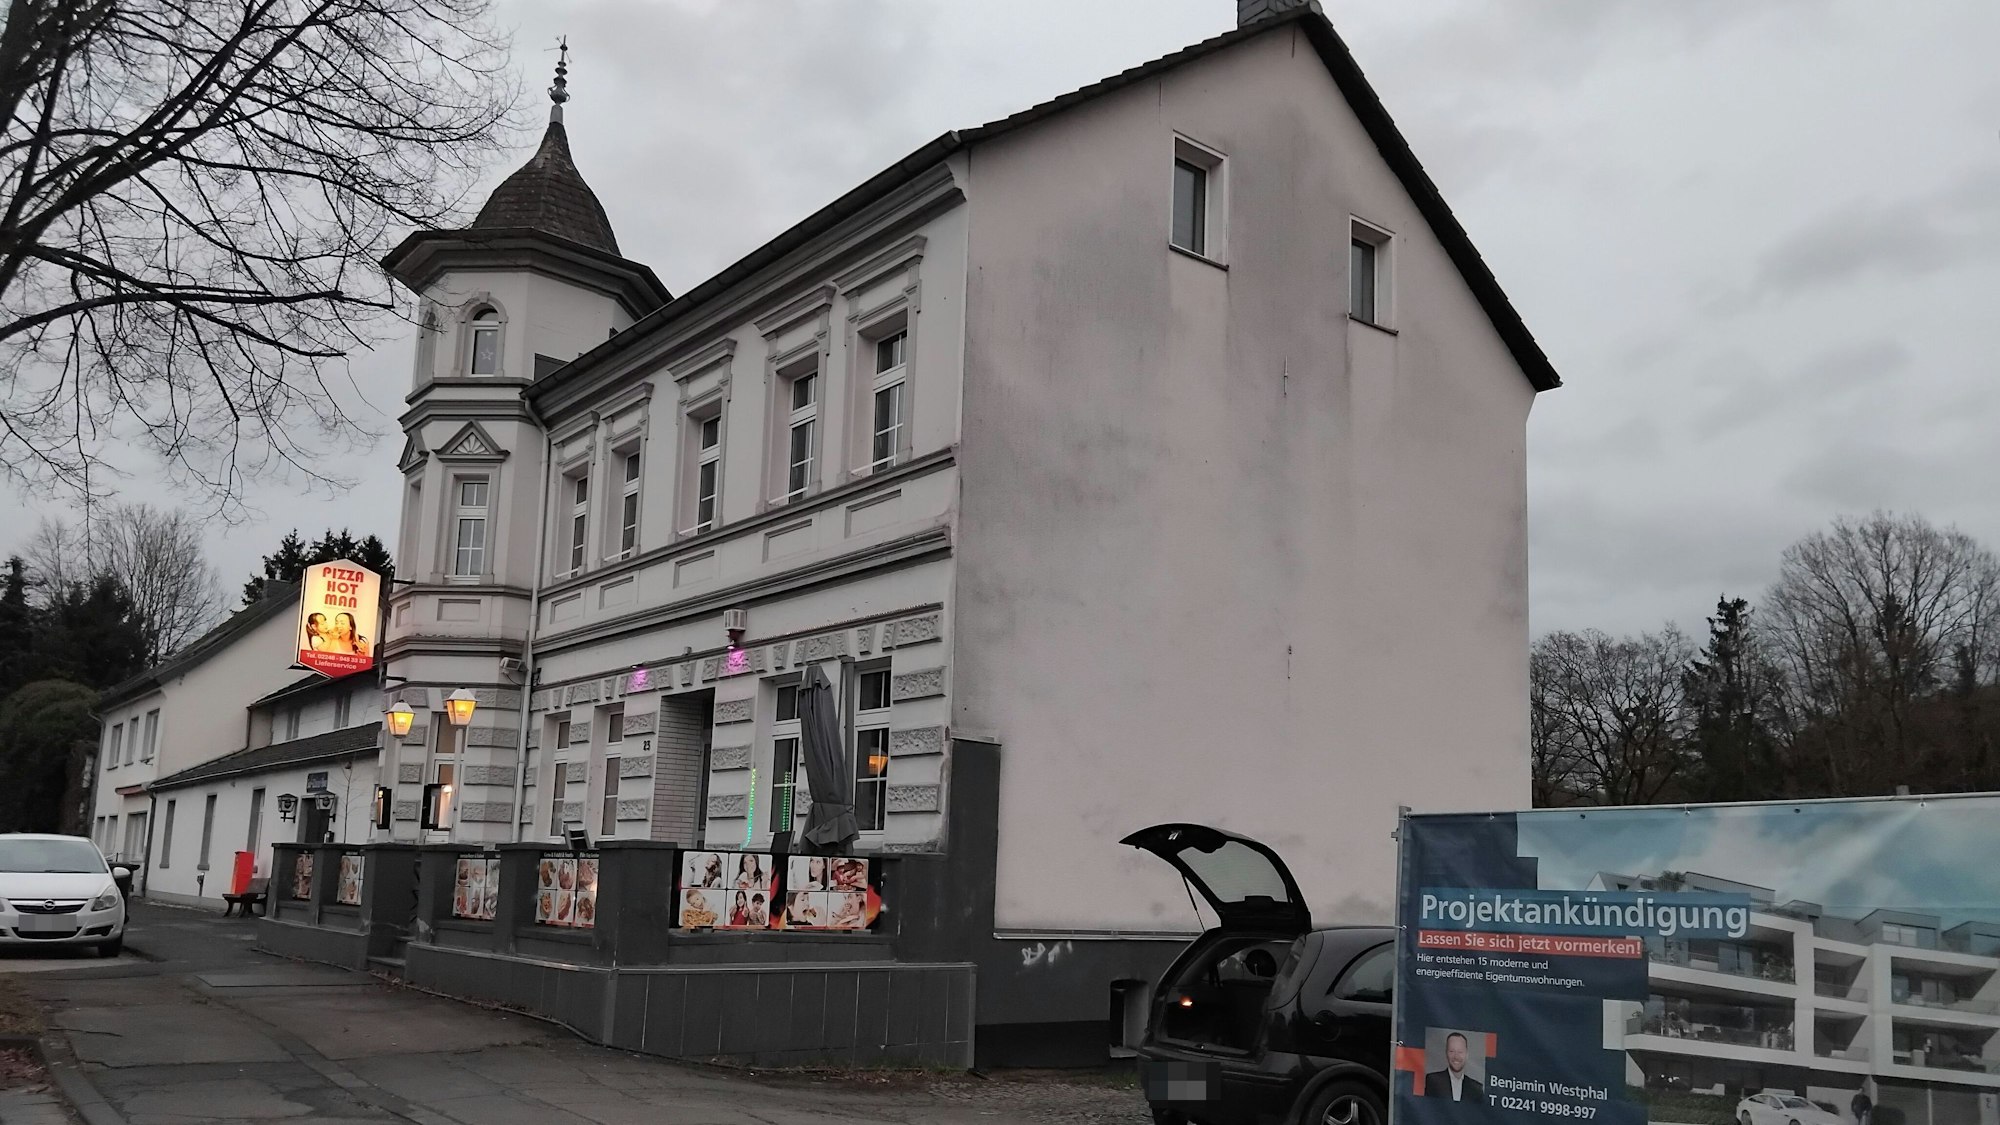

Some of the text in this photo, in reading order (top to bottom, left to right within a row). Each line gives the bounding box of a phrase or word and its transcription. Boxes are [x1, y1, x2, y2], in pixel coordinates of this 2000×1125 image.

[323, 567, 364, 582] PIZZA
[327, 581, 358, 594] HOT
[325, 594, 357, 608] MAN
[315, 660, 357, 669] Lieferservice
[1422, 894, 1747, 938] Projektankündigung
[1419, 931, 1641, 955] Lassen Sie sich jetzt vormerken!
[1416, 953, 1549, 970] Hier entstehen 15 moderne und
[1416, 967, 1585, 989] energieeffiziente Eigentumswohnungen.
[1490, 1075, 1608, 1101] Benjamin Westphal
[1488, 1094, 1596, 1120] T 02241 9998-997
